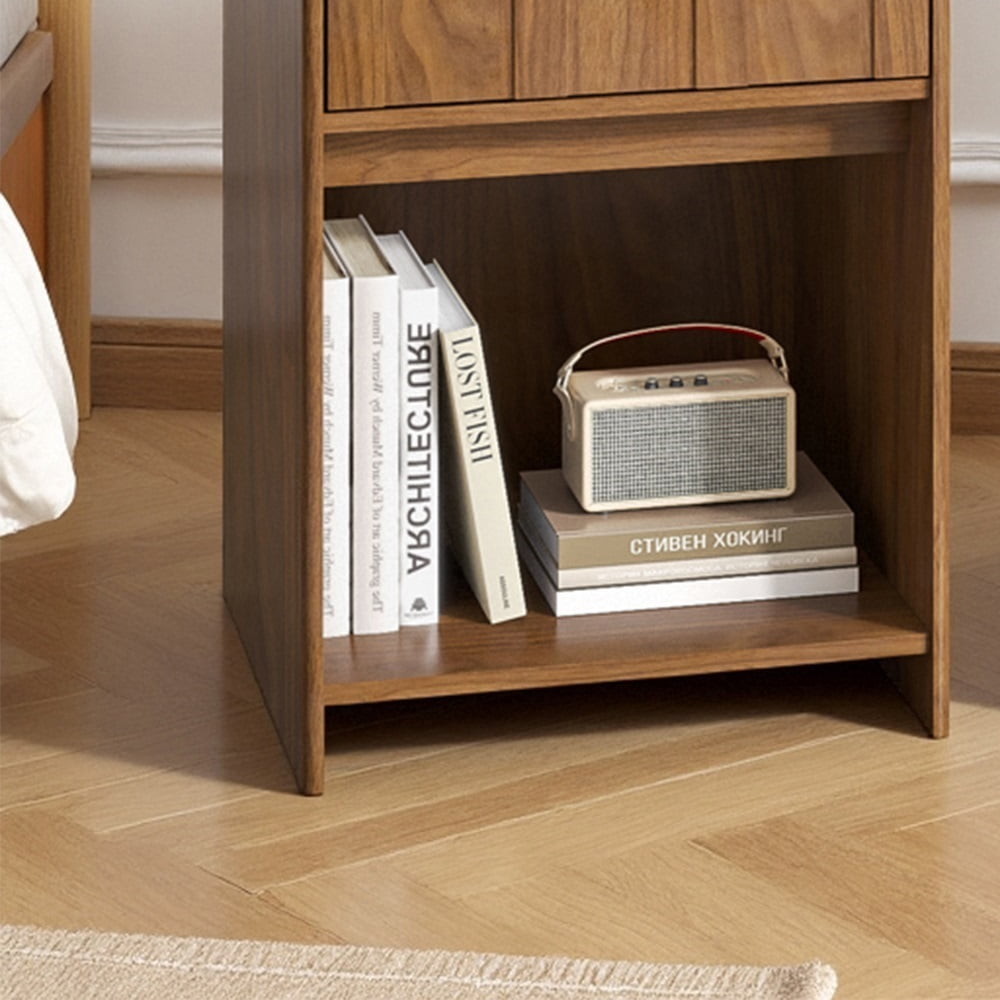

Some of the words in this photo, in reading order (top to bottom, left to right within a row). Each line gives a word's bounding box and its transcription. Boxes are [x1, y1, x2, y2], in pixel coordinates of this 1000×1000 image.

[452, 337, 483, 399] LOST
[464, 407, 493, 463] FISH
[630, 534, 706, 555] СТИВЕН
[713, 527, 787, 548] ХОКИНГ
